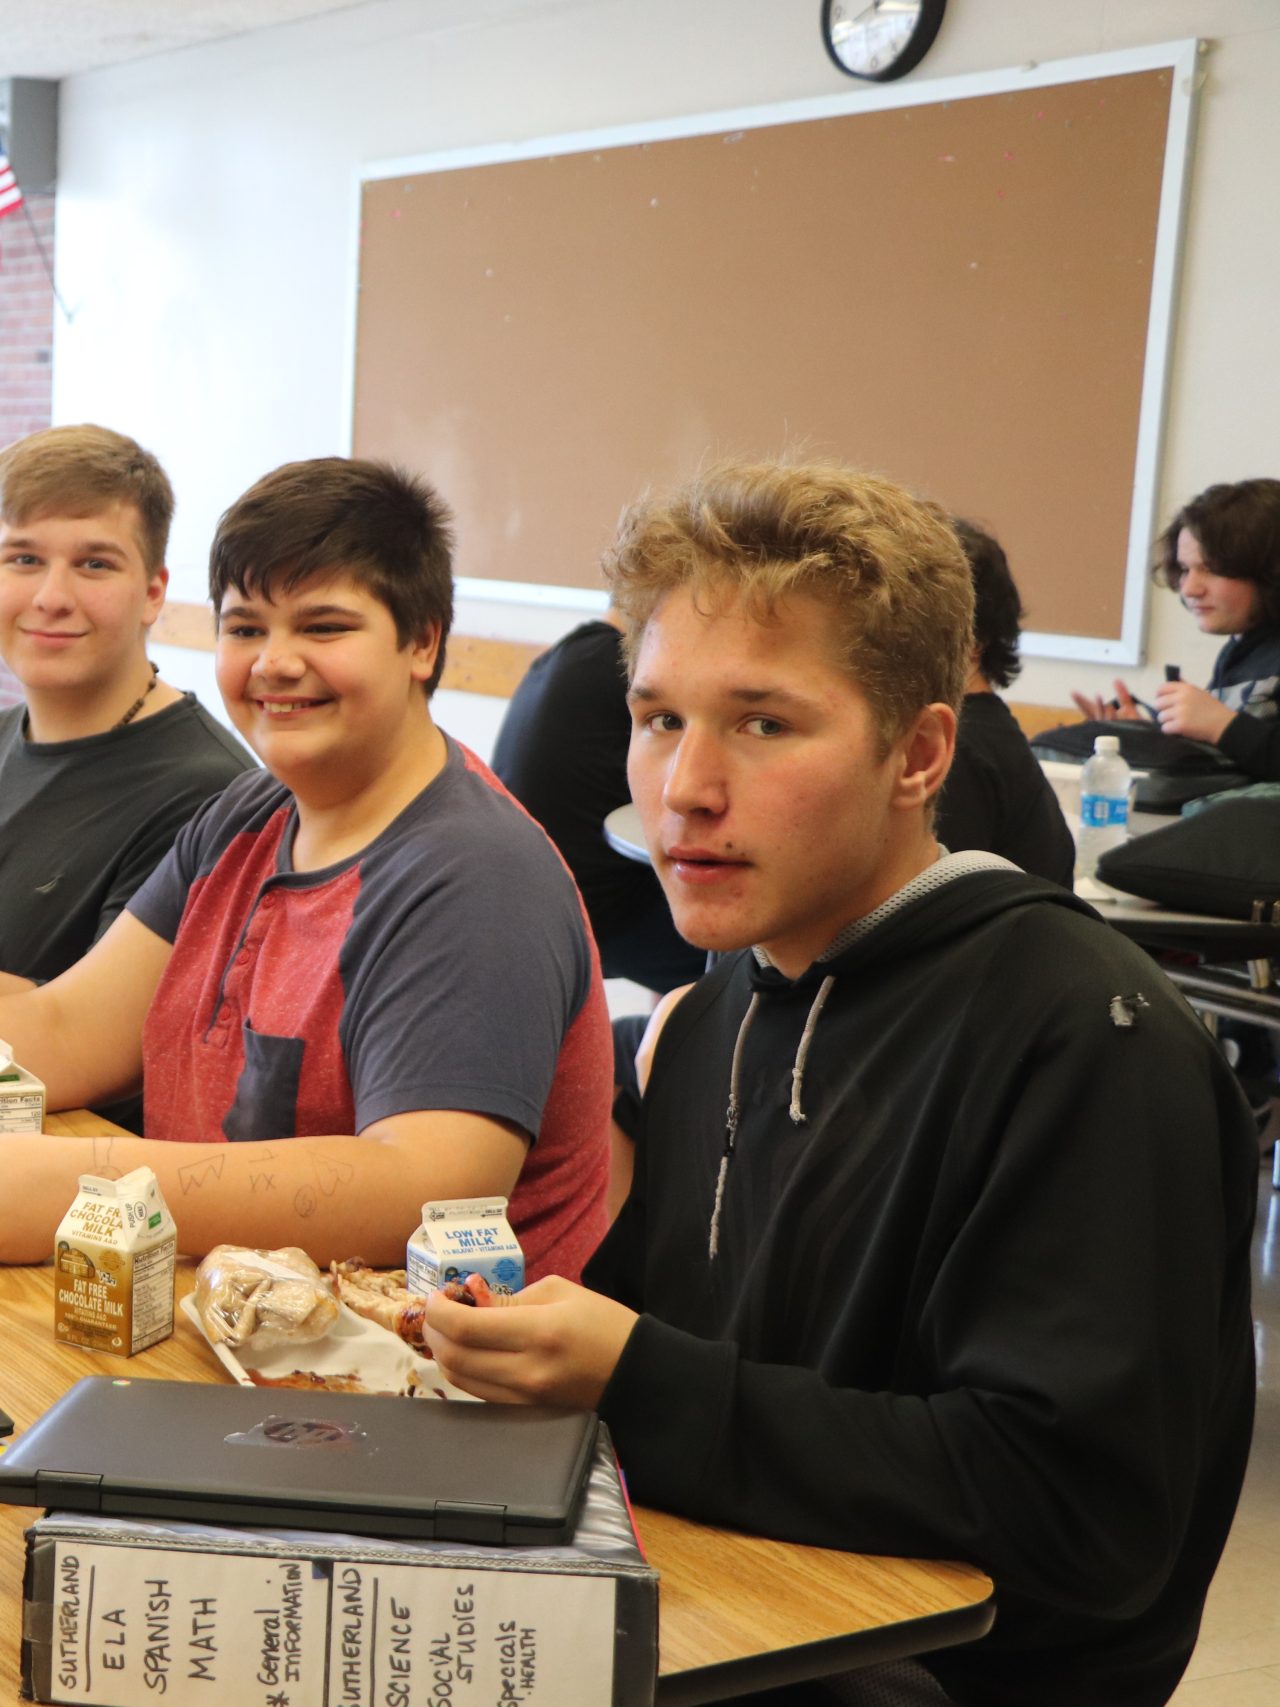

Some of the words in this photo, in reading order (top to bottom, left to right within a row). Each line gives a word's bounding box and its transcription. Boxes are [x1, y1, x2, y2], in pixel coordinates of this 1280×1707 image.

[82, 1201, 105, 1213] FAT
[82, 1221, 116, 1237] MILK
[445, 1229, 473, 1239] LOW
[476, 1227, 498, 1237] FAT
[459, 1236, 495, 1247] MILK
[58, 1288, 102, 1312] CHOCOLATE
[103, 1299, 124, 1317] MILK
[73, 1278, 87, 1294] FAT
[88, 1282, 108, 1300] FREE
[59, 1555, 80, 1690] SUTHERLAND
[102, 1608, 126, 1670] ELA
[187, 1598, 219, 1681] MATH
[254, 1609, 280, 1686] General
[337, 1567, 365, 1707] UTHERLAND
[385, 1597, 412, 1707] SCIENCE
[520, 1628, 536, 1689] HEALTH
